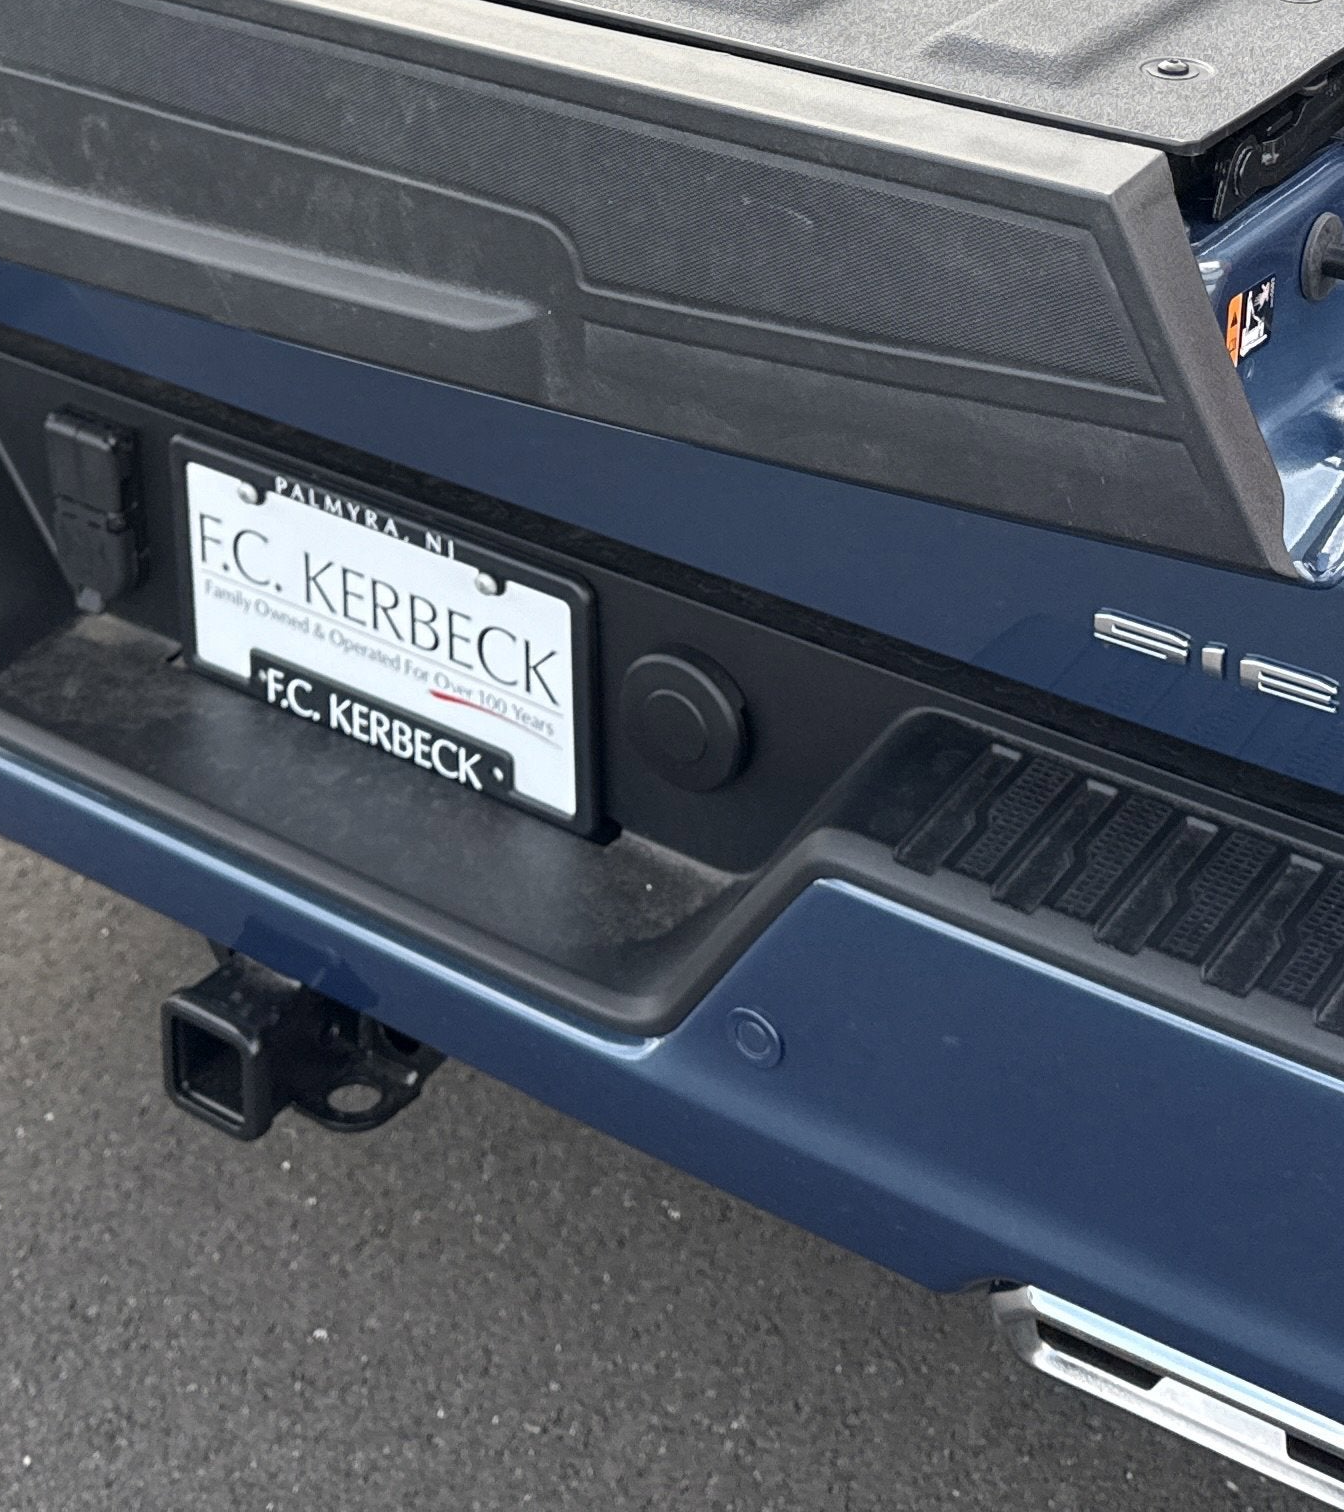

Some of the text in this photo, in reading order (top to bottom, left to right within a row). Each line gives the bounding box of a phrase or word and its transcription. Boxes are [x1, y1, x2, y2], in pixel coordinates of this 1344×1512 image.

[274, 475, 409, 543] PALMYRA,
[198, 513, 561, 707] F.C. KERBECK
[204, 578, 555, 736] Family Owned & Operated For Over 100 Years
[266, 667, 483, 791] F.C. KERBECK
